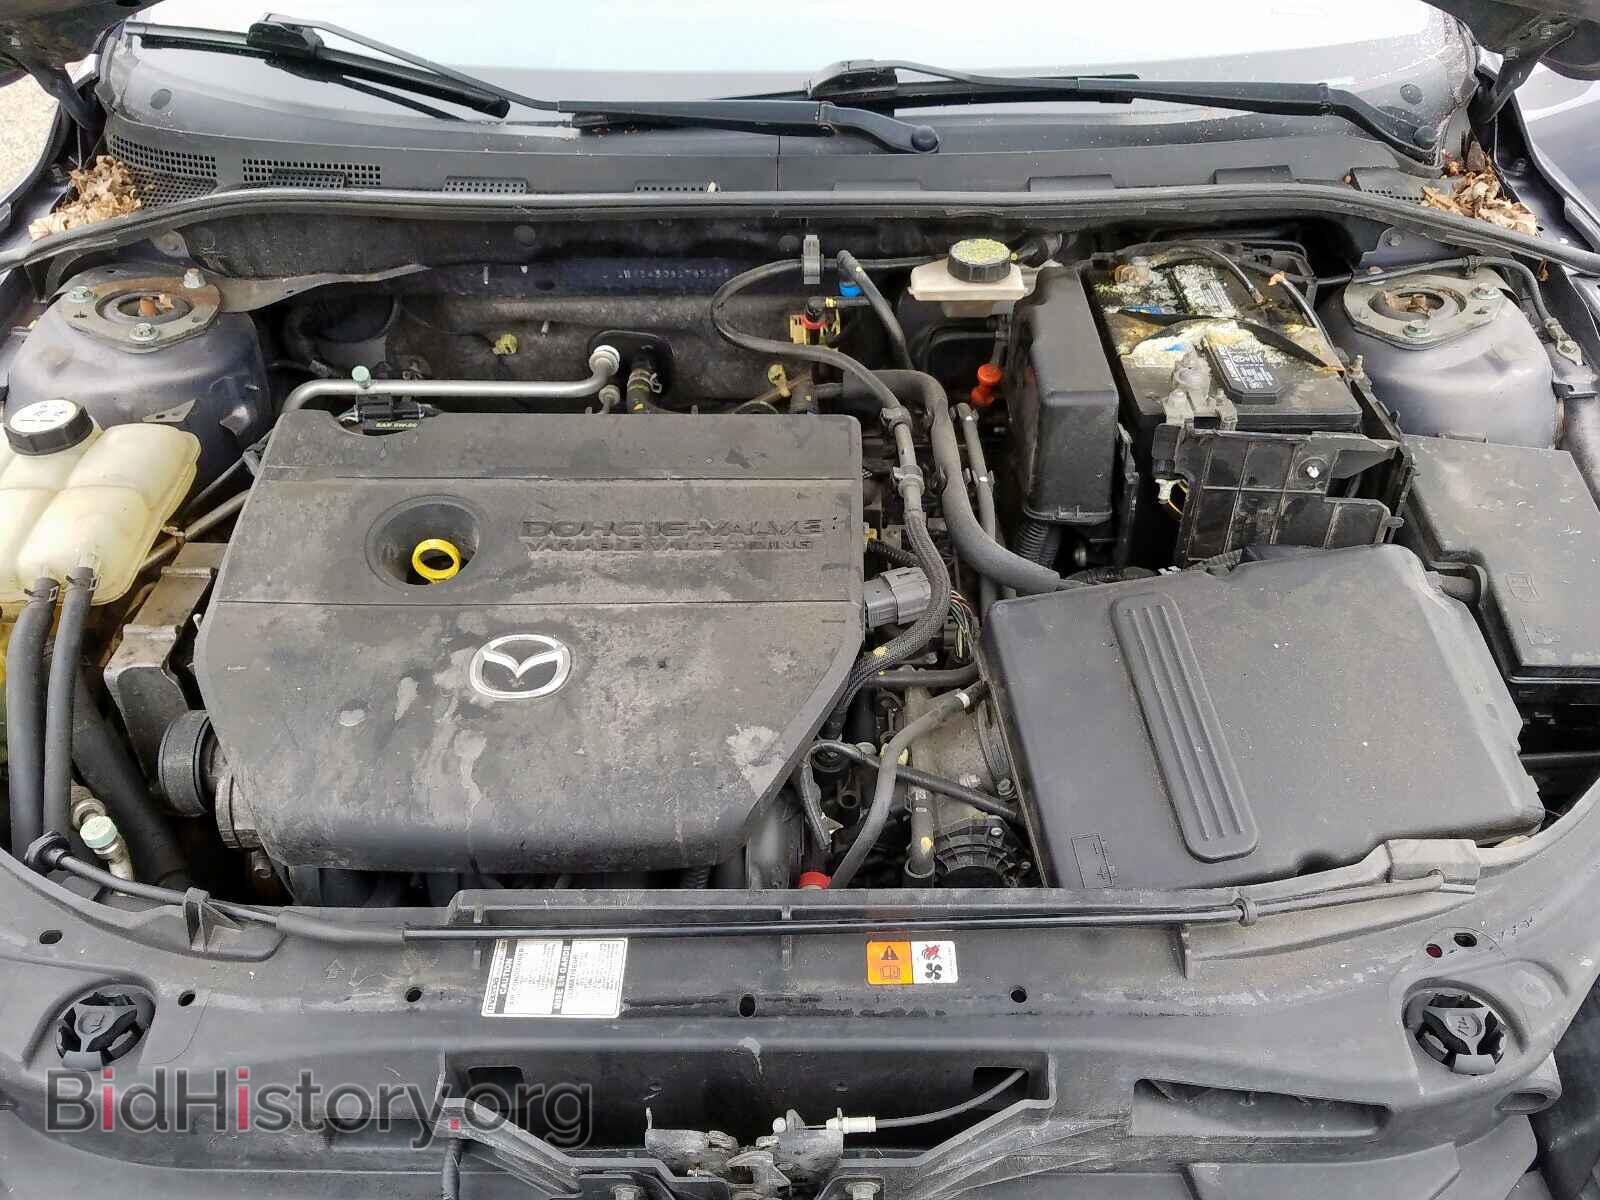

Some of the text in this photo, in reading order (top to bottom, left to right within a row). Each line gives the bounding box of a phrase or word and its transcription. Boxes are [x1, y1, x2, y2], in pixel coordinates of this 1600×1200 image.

[499, 958, 512, 994] CAUTION
[553, 945, 570, 1008] MISE EN GARDE
